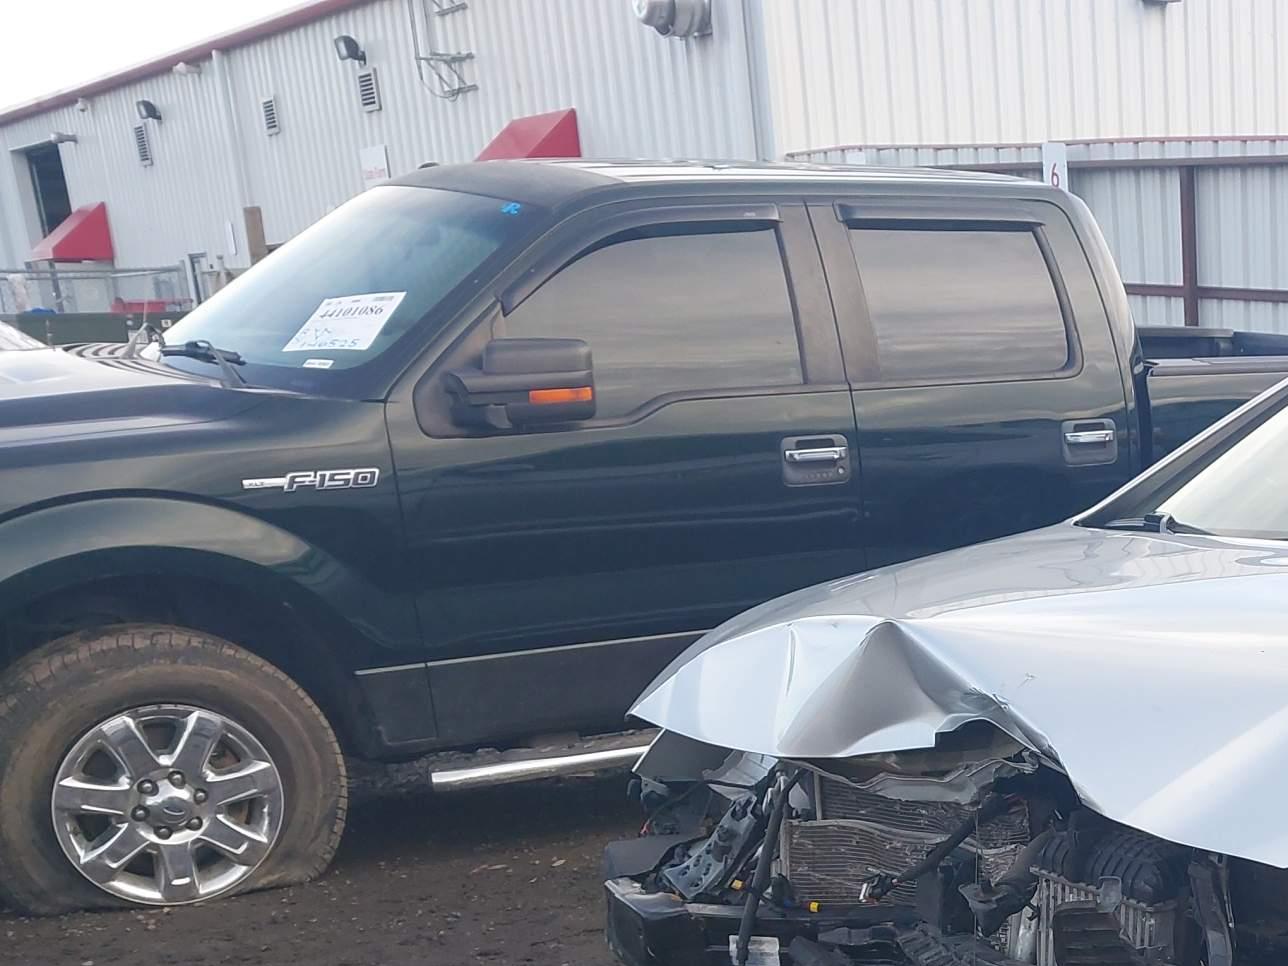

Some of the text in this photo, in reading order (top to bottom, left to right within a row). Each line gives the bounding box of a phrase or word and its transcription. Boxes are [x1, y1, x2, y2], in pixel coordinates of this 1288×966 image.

[1051, 162, 1060, 188] 6
[320, 305, 384, 319] 44101086
[284, 468, 380, 492] F-150
